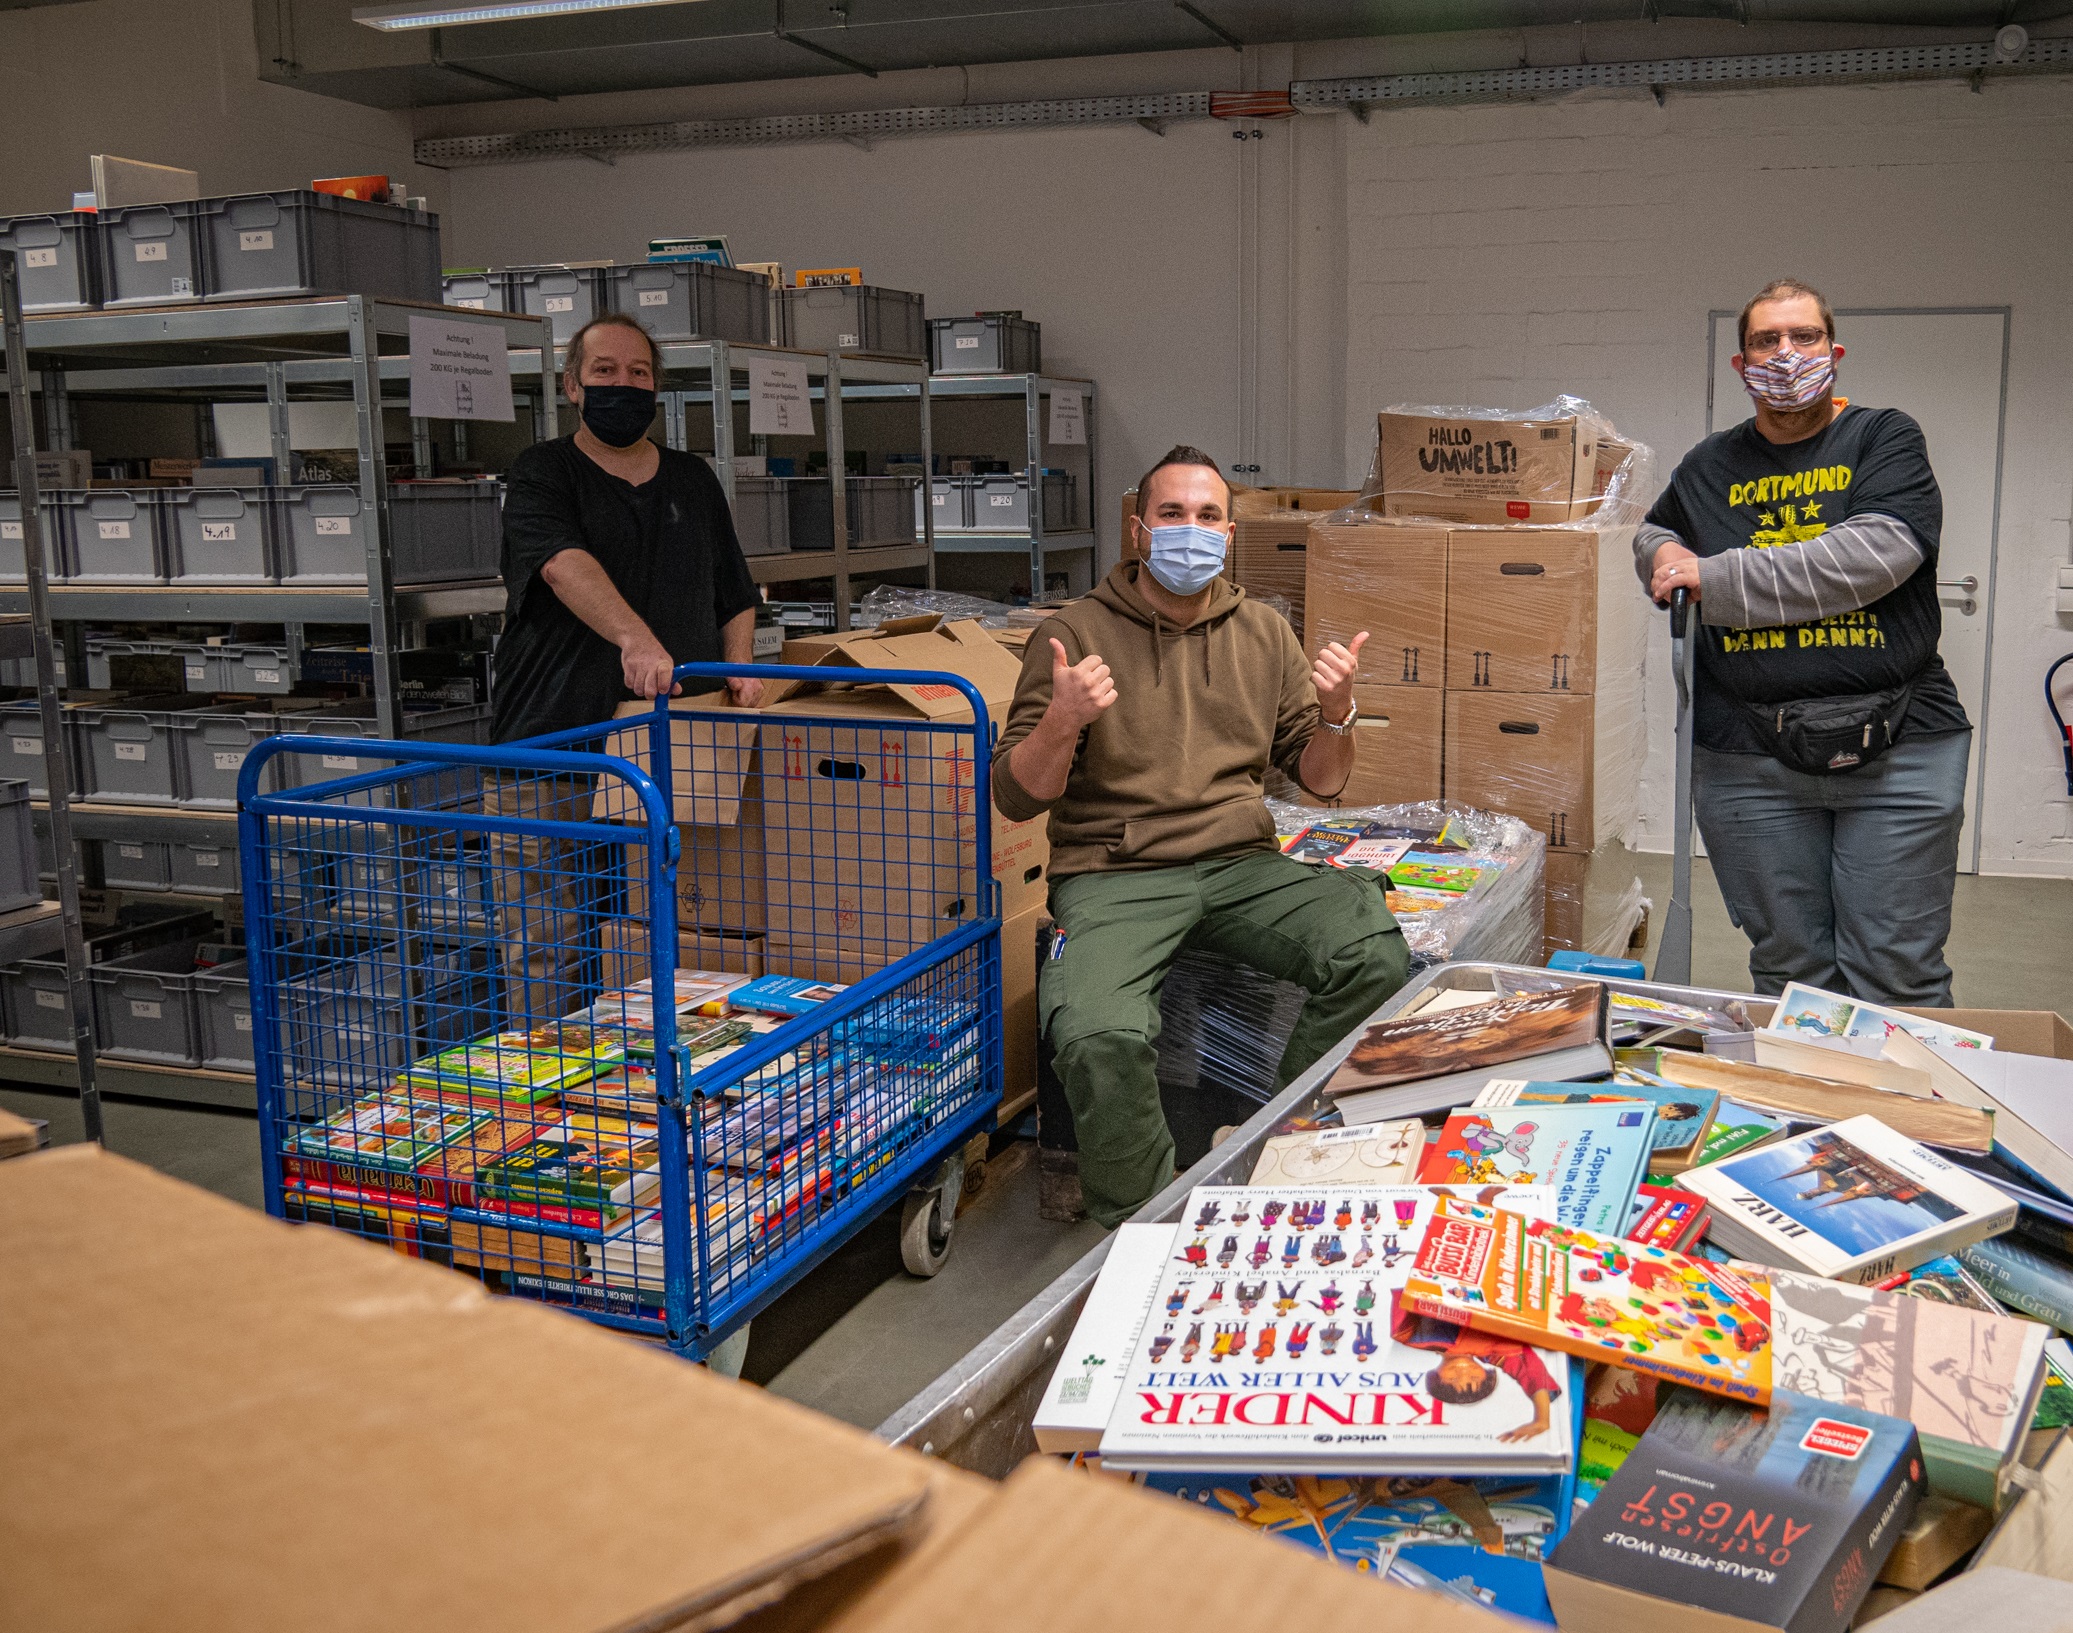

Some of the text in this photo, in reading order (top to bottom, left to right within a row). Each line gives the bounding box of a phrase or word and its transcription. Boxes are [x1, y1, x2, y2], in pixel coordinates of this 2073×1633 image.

[446, 334, 472, 345] Achtung
[433, 349, 490, 362] Maximale Beladung
[430, 364, 494, 377] 200 KG je Regalboden
[781, 382, 797, 390] Beladung
[1428, 427, 1472, 446] HALLO
[1418, 440, 1518, 475] UMWELT!
[298, 466, 332, 481] Atlas
[1729, 464, 1853, 508] DORTMUND
[204, 525, 230, 539] 4.19
[1723, 630, 1786, 653] WANN
[1569, 1129, 1594, 1166] reigen
[1552, 1150, 1563, 1165] neue
[337, 1165, 435, 1200] Germania
[1564, 1166, 1580, 1183] um
[1247, 1188, 1274, 1196] Harry
[1502, 1191, 1541, 1200] Loewe
[1559, 1184, 1577, 1202] die
[1571, 1145, 1611, 1228] Zappelfinger
[1731, 1192, 1810, 1239] HARZ
[1433, 1243, 1463, 1278] BUSSI
[1462, 1228, 1490, 1283] Kinderbibliothek
[1495, 1214, 1519, 1310] Spaß im Kinderzimmer
[1955, 1247, 2011, 1281] Meer in
[1174, 1269, 1381, 1278] Barnabas und Anabel Kindersley
[1858, 1256, 1895, 1285] HARZ
[620, 1292, 634, 1302] DAS
[1967, 1269, 1994, 1290] old
[1994, 1284, 2019, 1303] und
[2020, 1294, 2062, 1322] Grau
[1138, 1371, 1425, 1388] AUS ALLER WELT
[1622, 1355, 1707, 1385] Kinderzimmer
[1135, 1392, 1449, 1426] KINDER
[1121, 1431, 1160, 1439] Nationen
[1162, 1432, 1211, 1440] Vereinten
[1230, 1432, 1289, 1440] Kinderhilfswerk
[1337, 1433, 1387, 1444] unicef
[1591, 1435, 1609, 1449] mit
[1809, 1433, 1860, 1453] SPIEGEL
[1655, 1467, 1716, 1490] Kriminalroman
[1625, 1484, 1813, 1548] ANGST
[1620, 1509, 1791, 1567] Ostfriesen
[1602, 1530, 1778, 1584] KLAUS-PETER WOLF
